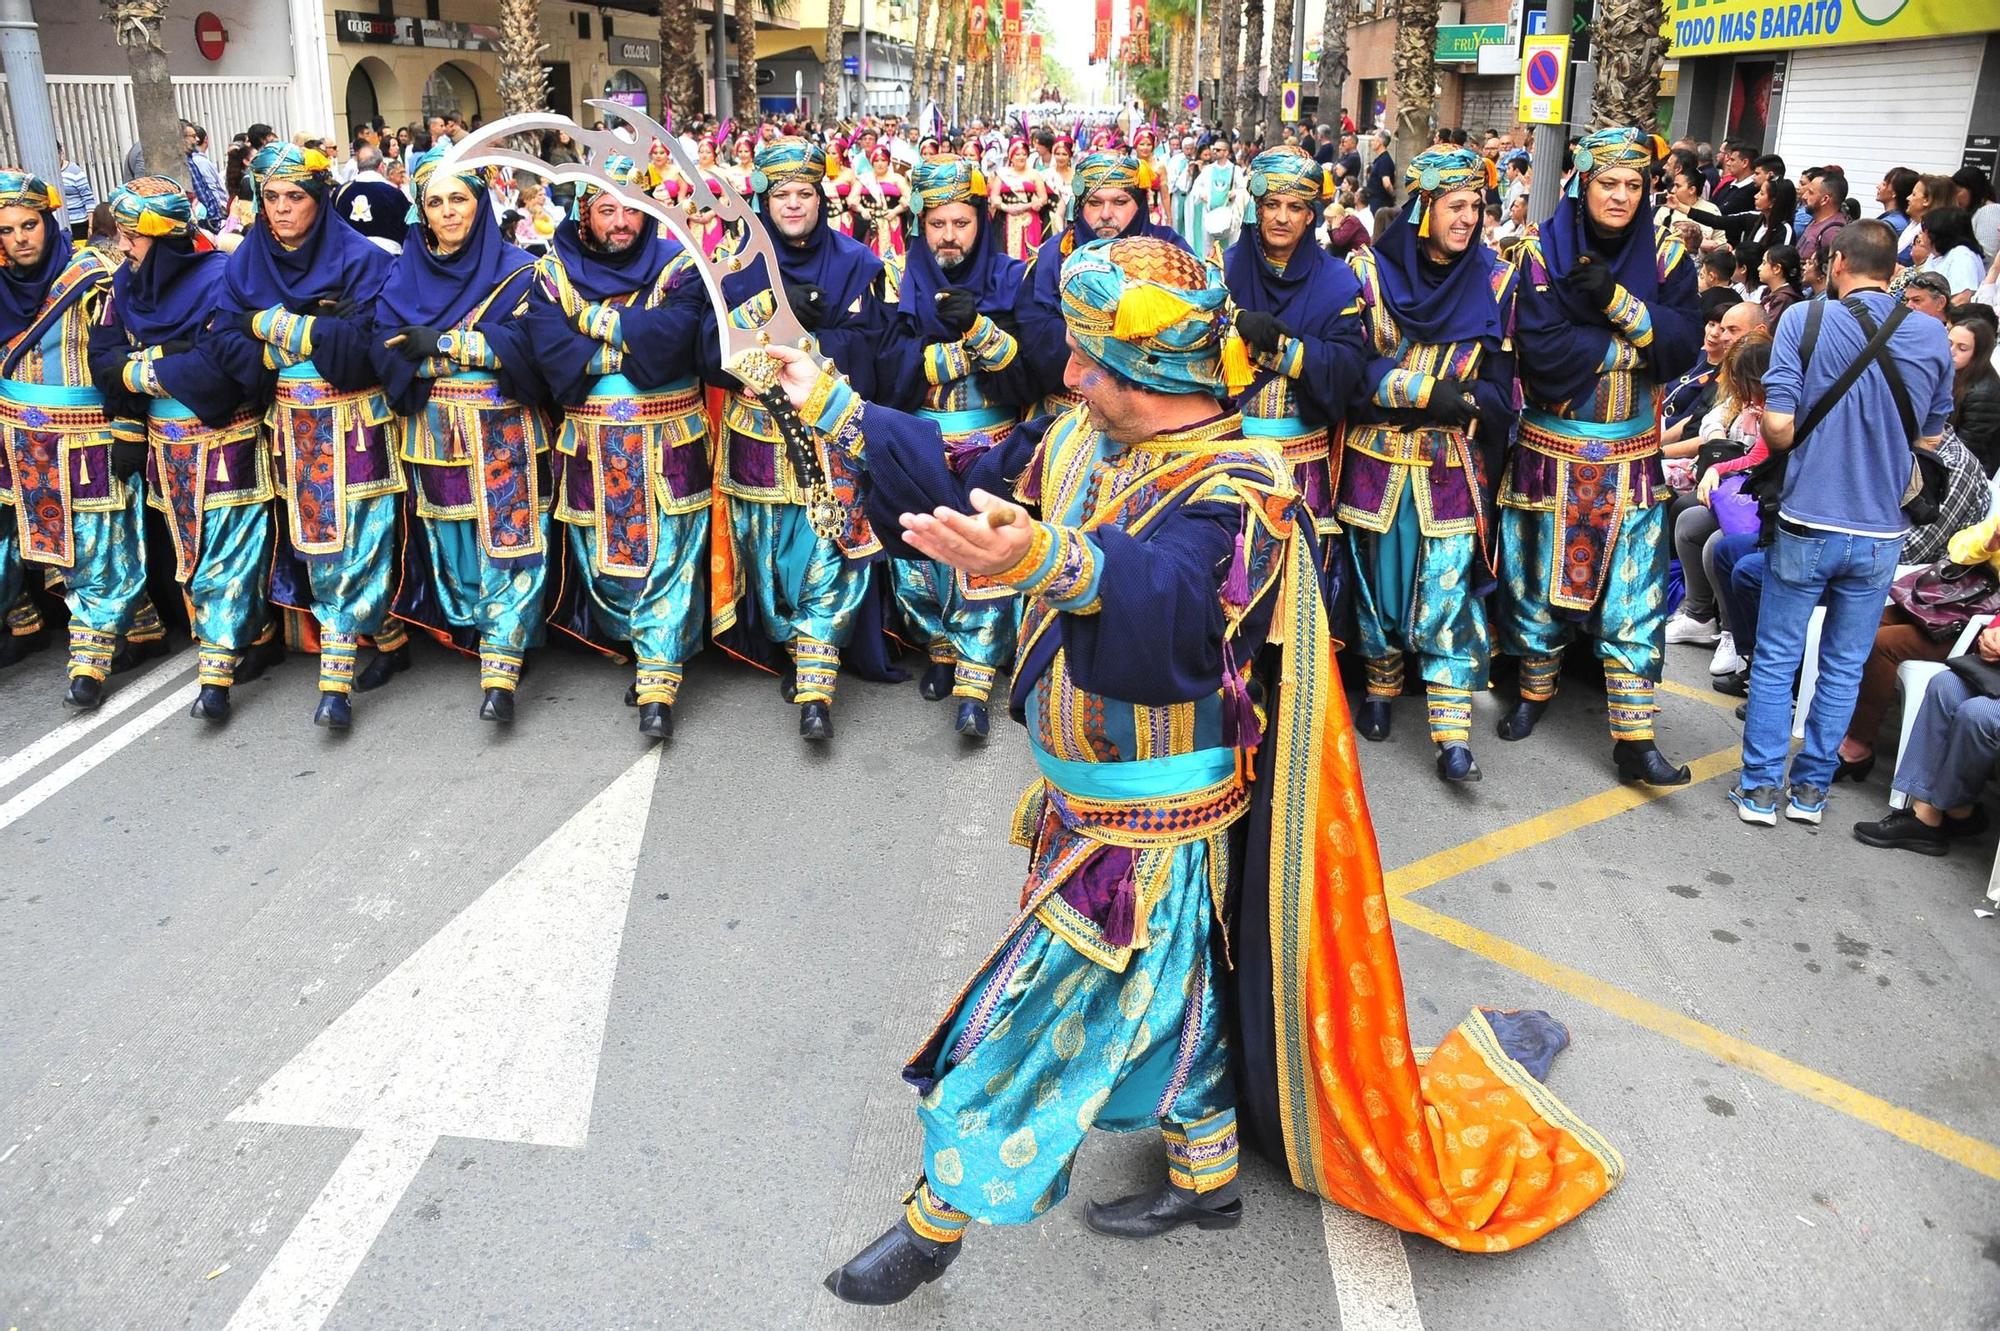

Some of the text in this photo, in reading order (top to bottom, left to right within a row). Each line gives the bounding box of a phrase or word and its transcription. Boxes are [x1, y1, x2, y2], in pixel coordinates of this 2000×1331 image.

[1675, 0, 1842, 48] TODO MAS BARATO
